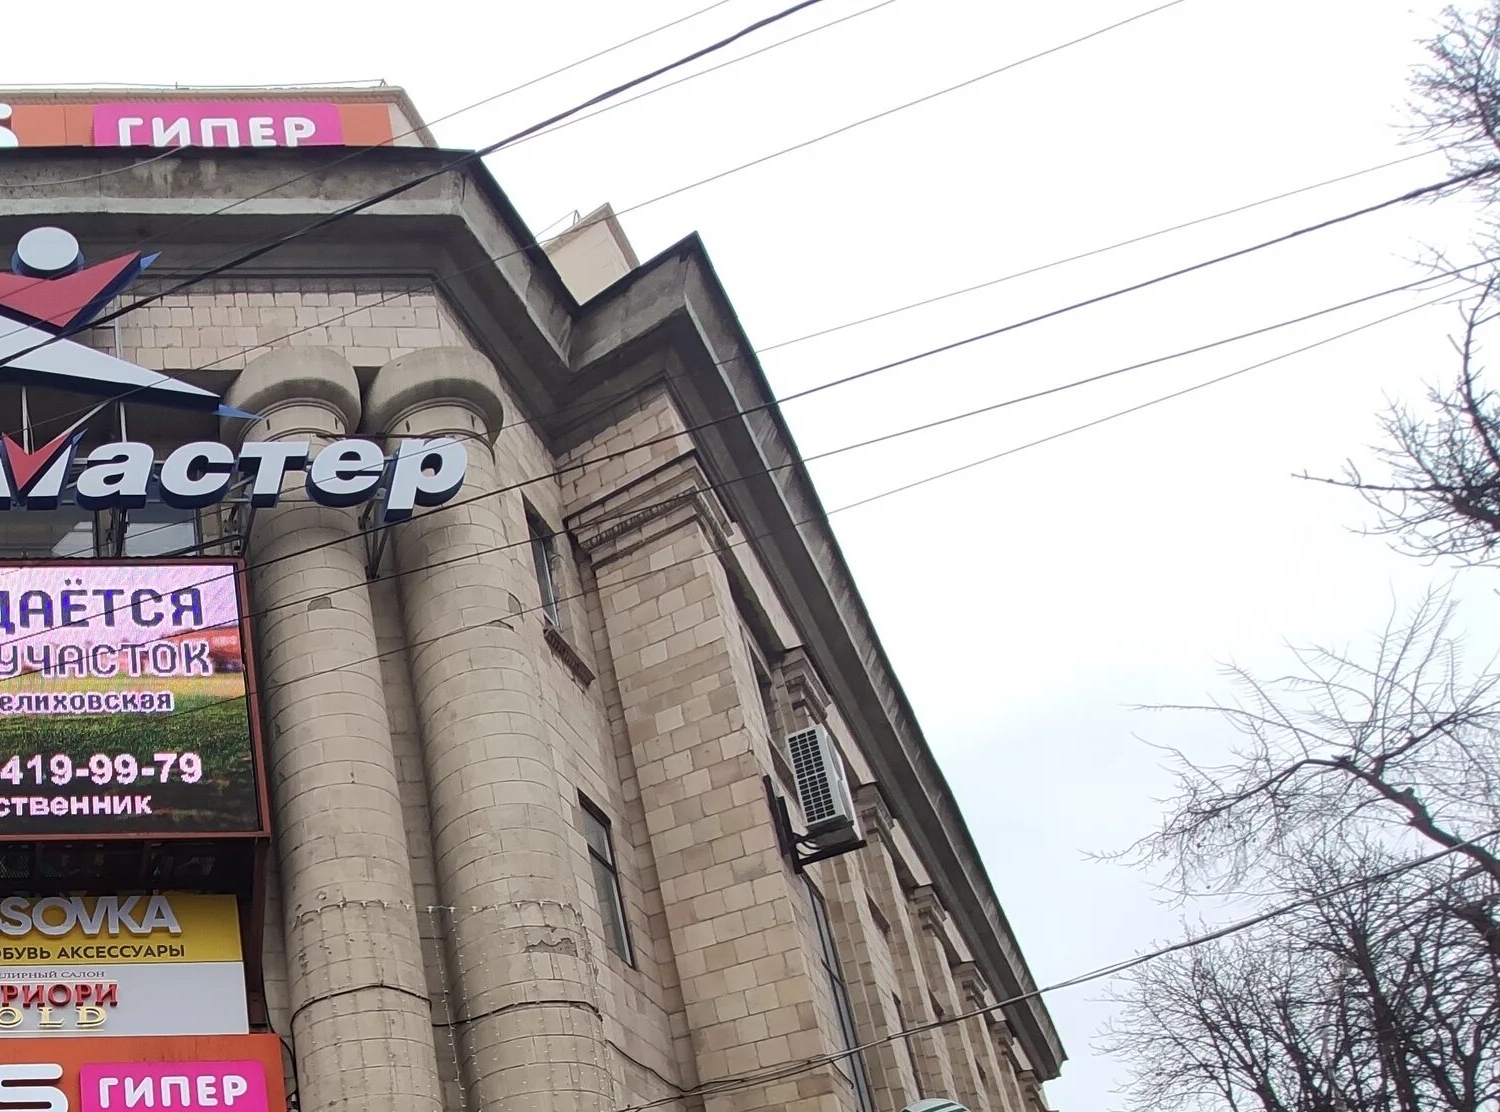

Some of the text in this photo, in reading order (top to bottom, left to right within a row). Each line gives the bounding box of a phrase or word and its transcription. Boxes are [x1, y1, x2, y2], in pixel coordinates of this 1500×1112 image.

[117, 115, 318, 147] ГИПЕР
[57, 943, 186, 960] АКСЕССУАРЫ
[60, 971, 106, 979] САЛОН
[99, 1073, 249, 1109] ГИПЕР
